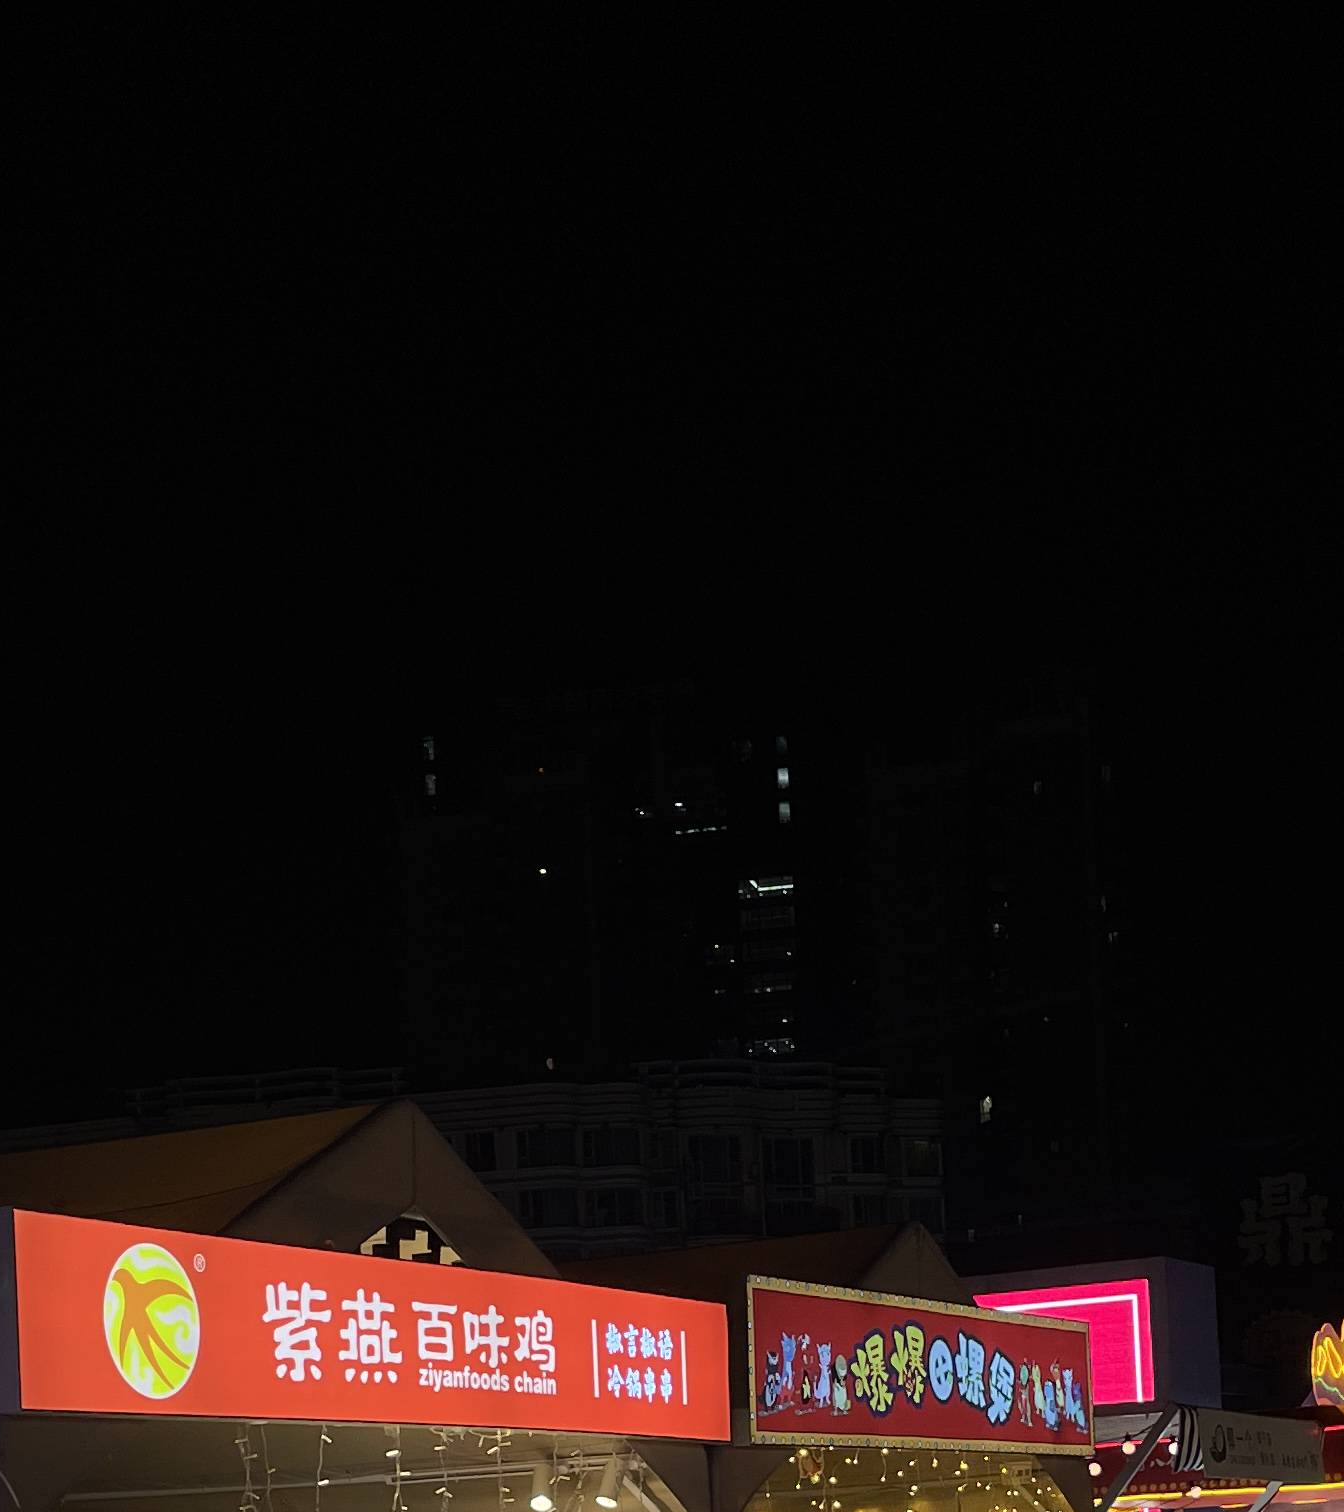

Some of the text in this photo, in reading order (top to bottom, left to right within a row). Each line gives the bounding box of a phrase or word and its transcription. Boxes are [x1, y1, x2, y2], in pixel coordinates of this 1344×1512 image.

[262, 1281, 556, 1384] 紫燕百味鸡
[419, 1366, 556, 1395] ziyanfoods chain
